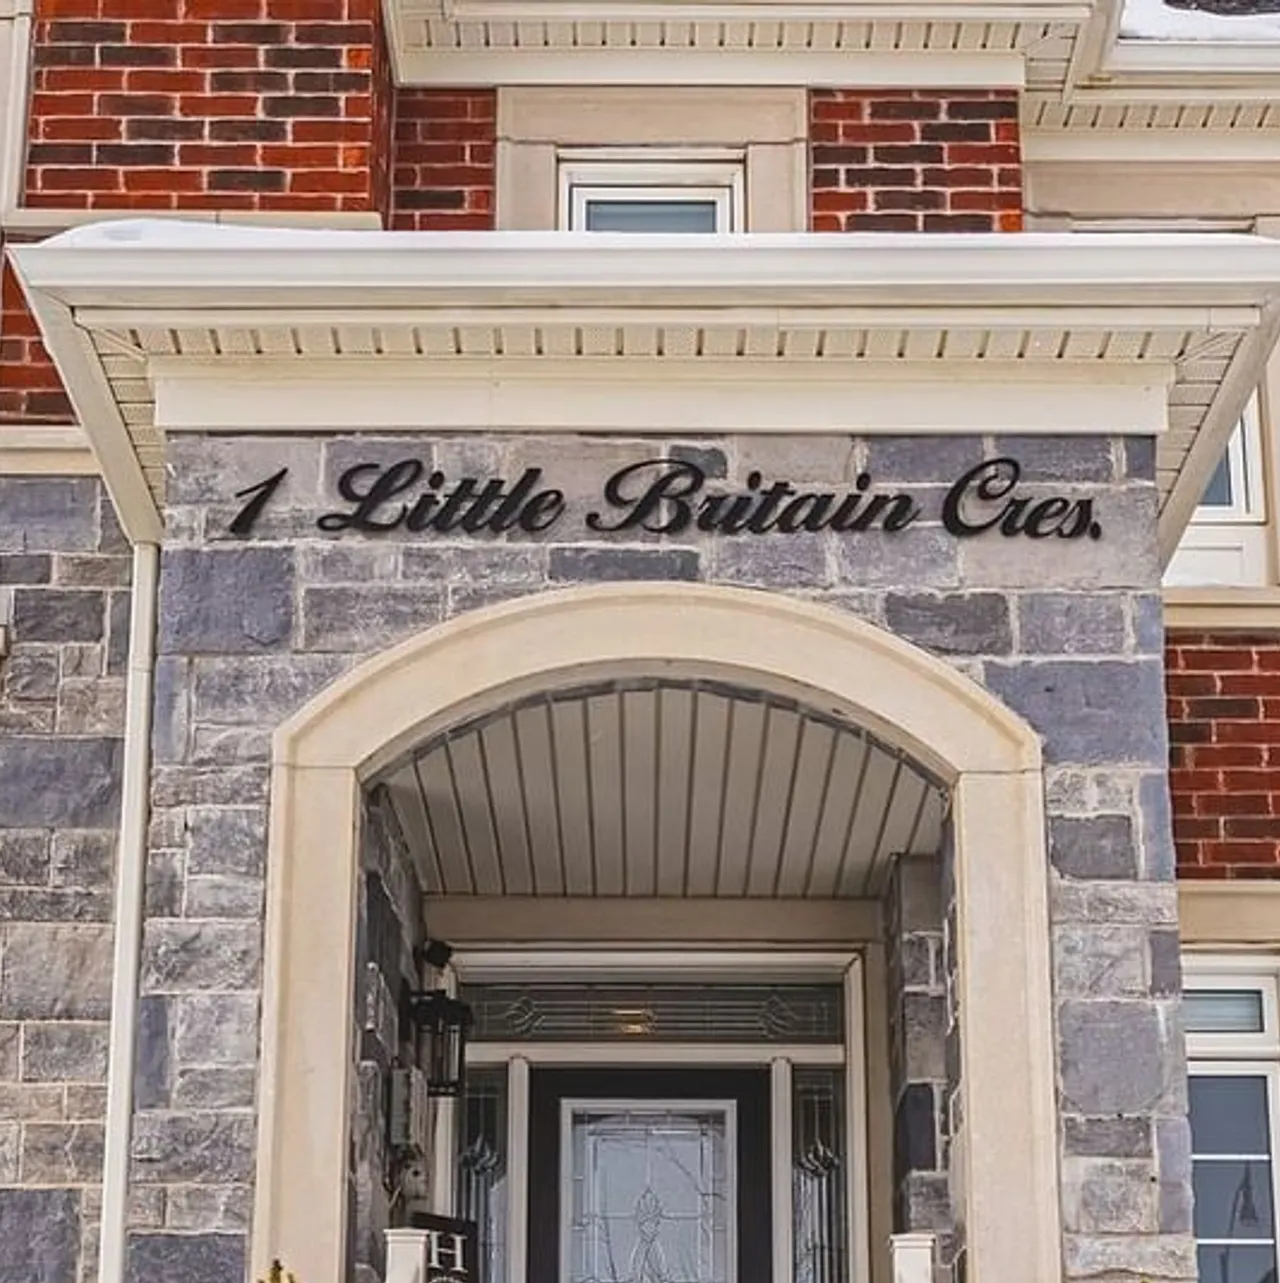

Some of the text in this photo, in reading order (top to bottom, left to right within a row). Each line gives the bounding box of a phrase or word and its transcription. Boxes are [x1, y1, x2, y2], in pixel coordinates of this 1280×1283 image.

[229, 457, 1102, 541] 1 Little Britain Cres.
